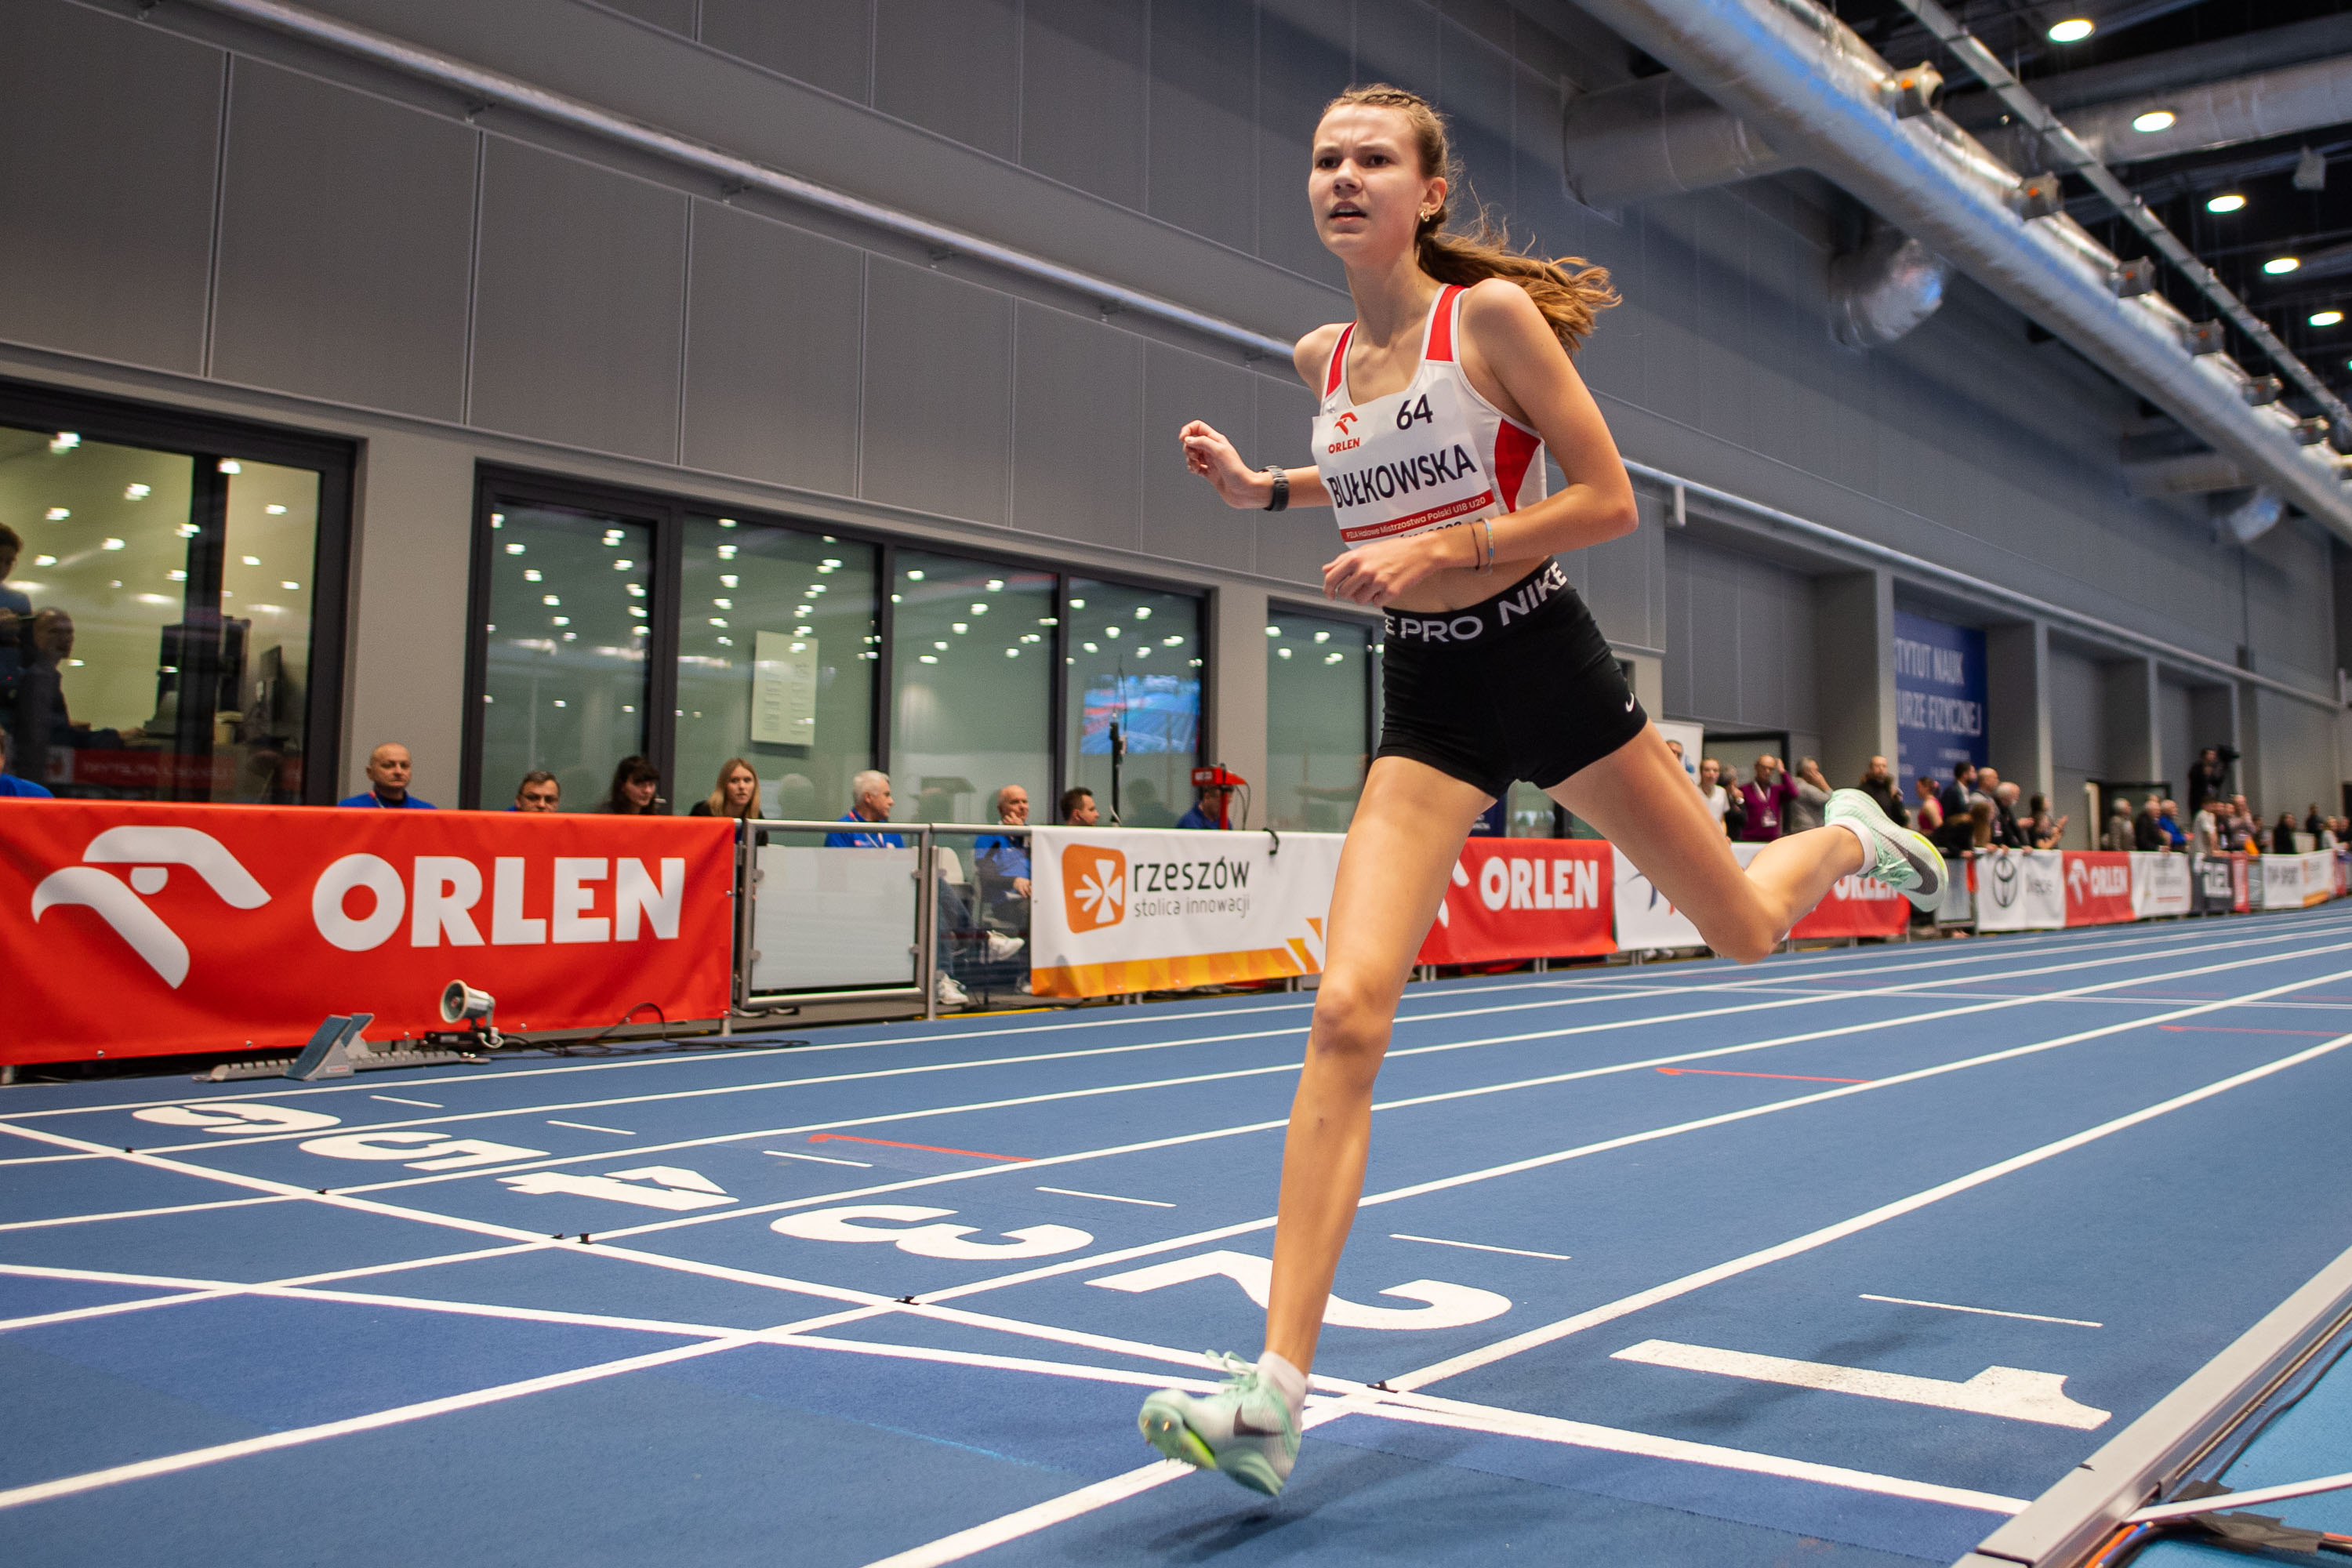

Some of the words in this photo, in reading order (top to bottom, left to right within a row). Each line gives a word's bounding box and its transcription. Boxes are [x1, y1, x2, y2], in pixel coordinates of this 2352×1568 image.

[1396, 394, 1433, 430] 64
[1328, 437, 1360, 454] ORLEN
[1327, 444, 1478, 509] BUŁKOWSKA
[1380, 516, 1426, 534] Mistrzostwa
[1428, 509, 1451, 521] Polski
[1453, 503, 1468, 514] U18
[1469, 496, 1486, 509] U20
[1400, 616, 1483, 642] PRO
[1498, 561, 1568, 626] NIKE
[1933, 646, 1965, 686] NAUK
[1134, 855, 1250, 893] rzeszów
[1479, 856, 1599, 911] ORLEN
[2089, 865, 2129, 897] ORLEN
[313, 852, 685, 952] ORLEN
[1134, 898, 1181, 917] stolica
[1185, 895, 1250, 919] innowacji
[298, 1131, 552, 1171] 5
[495, 1165, 740, 1211] 4
[770, 1204, 1094, 1261] 3
[1084, 1250, 1512, 1331] 2
[1609, 1338, 2111, 1430] 1
